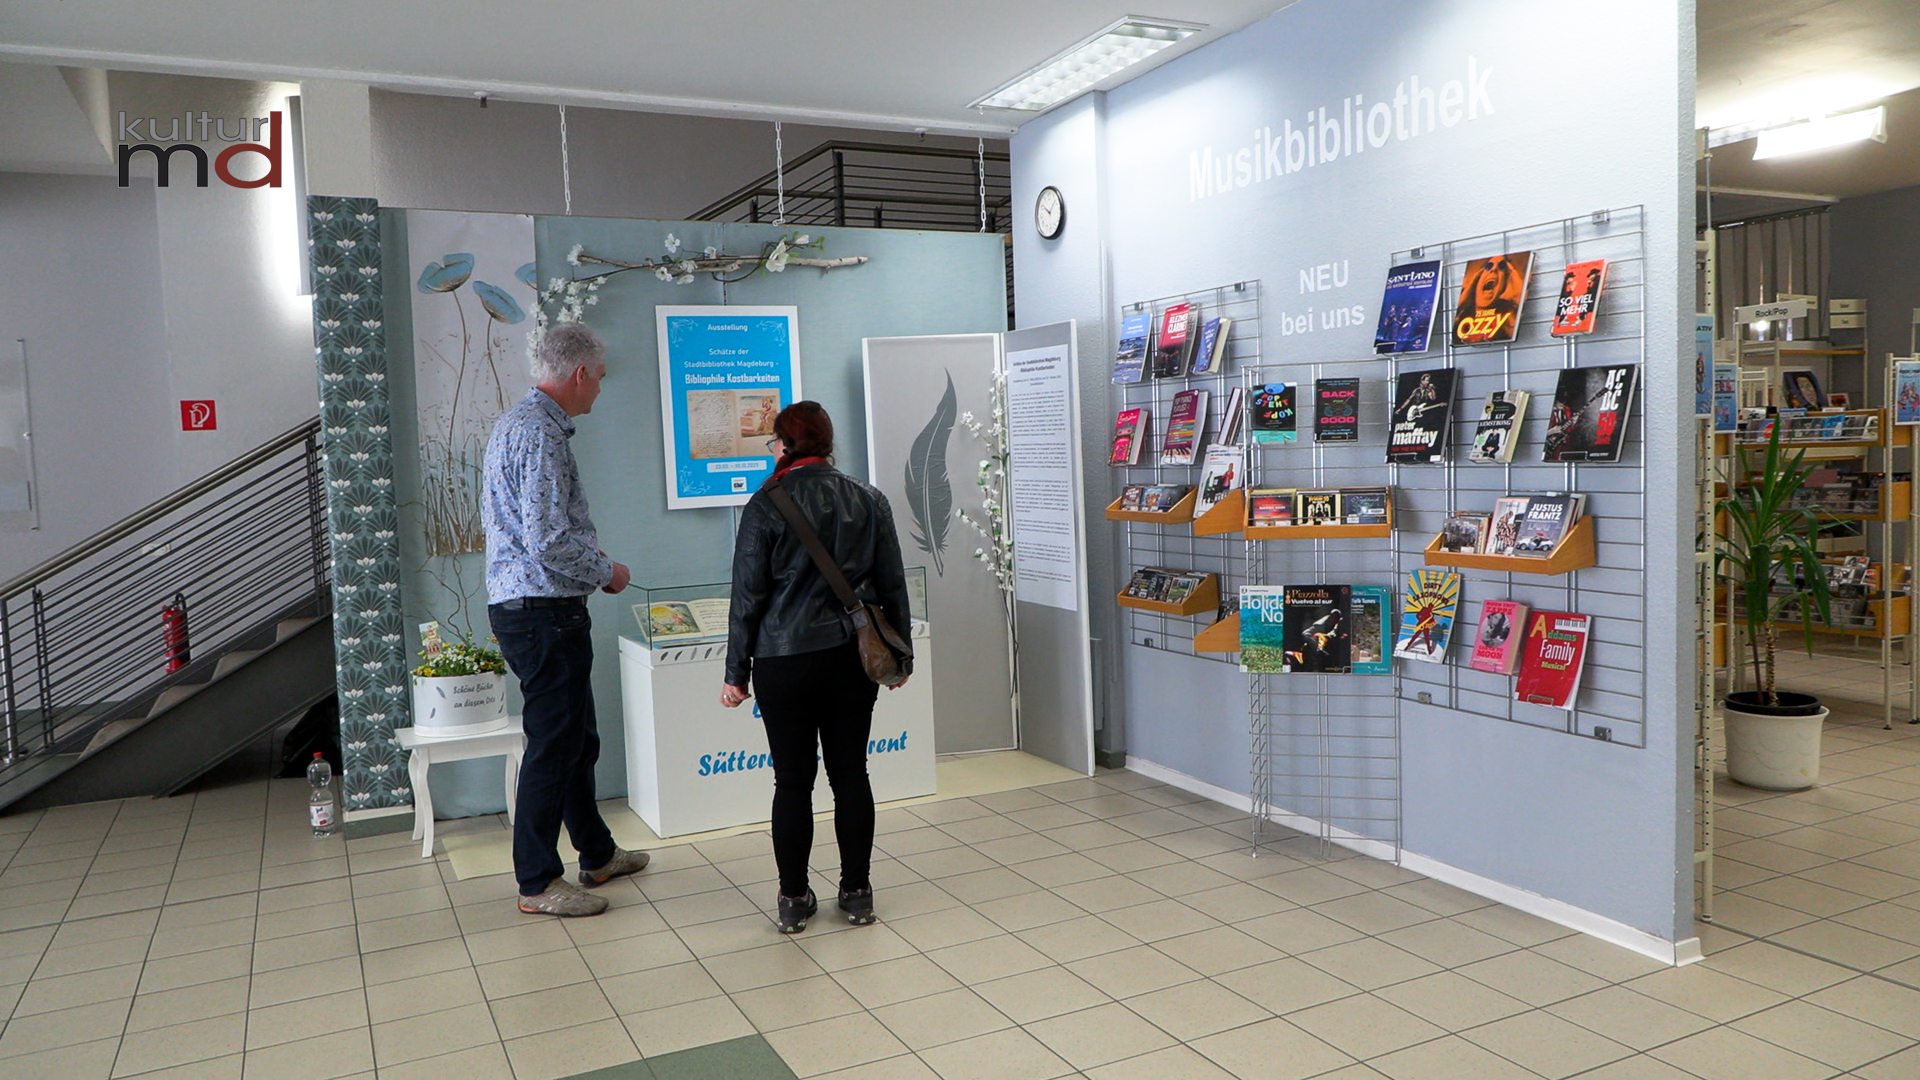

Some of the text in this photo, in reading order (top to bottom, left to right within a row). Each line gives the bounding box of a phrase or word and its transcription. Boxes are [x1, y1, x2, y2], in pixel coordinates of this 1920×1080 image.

[1189, 54, 1495, 201] Musikbibliothek
[1299, 260, 1349, 295] NEU
[1387, 271, 1435, 285] SANTIANO
[1559, 294, 1593, 307] SO VIEL
[1560, 303, 1588, 316] MEHR
[1755, 308, 1788, 318] Rock/Pop
[1281, 304, 1365, 336] bei uns
[707, 323, 748, 332] Ausstellung
[1457, 312, 1512, 340] OZZY
[684, 360, 735, 368] Stadtbibliothek
[736, 360, 774, 368] Magdeburg
[685, 372, 780, 386] Bibliophile Kostbarkeiten
[1321, 390, 1355, 398] BACK
[1320, 416, 1355, 424] GOOD
[1394, 420, 1416, 433] peter
[1392, 427, 1439, 447] maffay
[1530, 503, 1563, 512] JUSTUS
[1527, 511, 1562, 520] FRANTZ
[1423, 582, 1442, 590] DIRTY
[1291, 589, 1329, 598] Piazzolla
[1485, 606, 1513, 615] ZAPPA
[1529, 614, 1577, 642] Addams
[1476, 650, 1503, 659] MOON
[1539, 639, 1576, 666] Family
[1541, 661, 1566, 671] Musical
